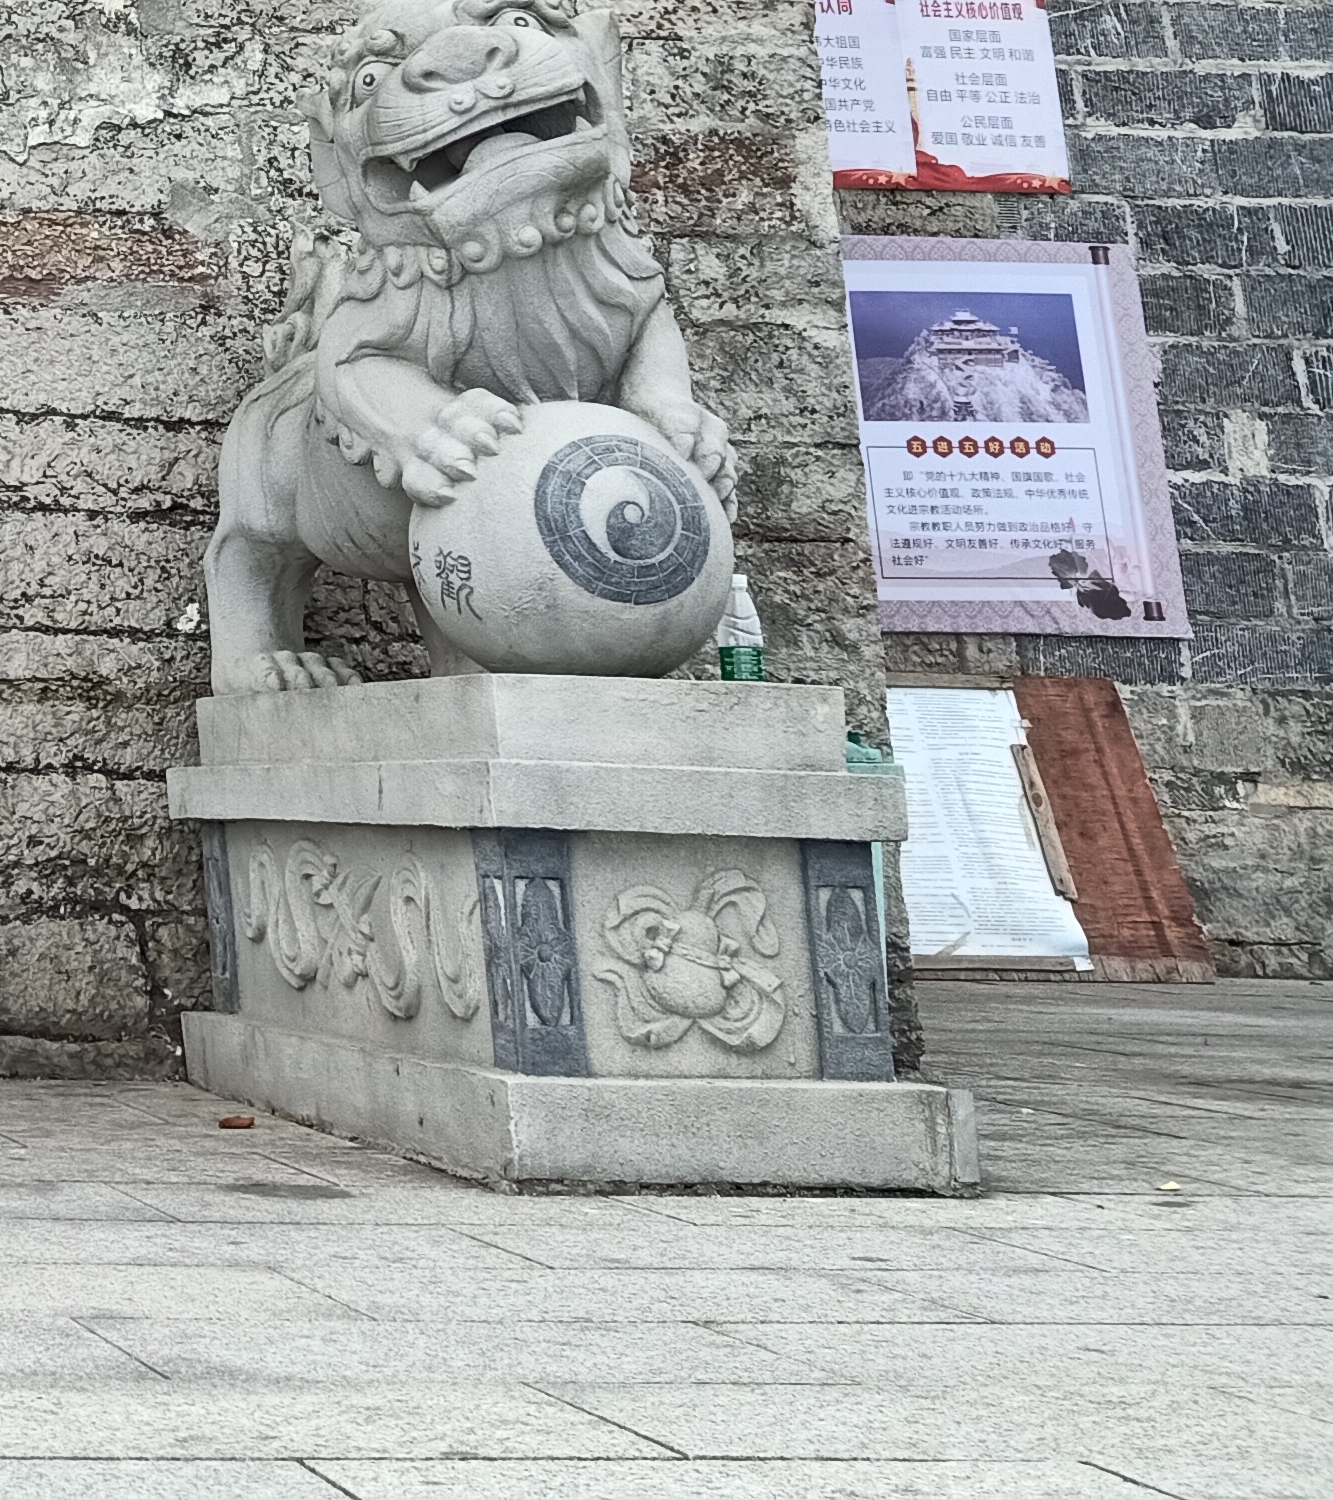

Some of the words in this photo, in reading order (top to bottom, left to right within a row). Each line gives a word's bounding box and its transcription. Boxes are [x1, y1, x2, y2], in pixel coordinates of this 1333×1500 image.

[919, 0, 1024, 21] 社会主义核心价值观
[949, 29, 1002, 43] 国家层面
[921, 46, 947, 59] 富强
[950, 47, 975, 60] 民主
[980, 48, 1005, 61] 文明
[1009, 48, 1035, 62] 和谐
[955, 72, 1008, 87] 社会层面
[927, 89, 952, 103] 自由
[956, 90, 982, 104] 平等
[985, 90, 1011, 104] 公正
[1014, 91, 1041, 105] 法治
[961, 115, 1014, 130] 公民层面
[931, 131, 958, 146] 爱国
[961, 132, 987, 147] 敬业
[991, 134, 1017, 148] 诚信
[1021, 134, 1047, 148] 友善
[911, 441, 1052, 453] 五进五好活动
